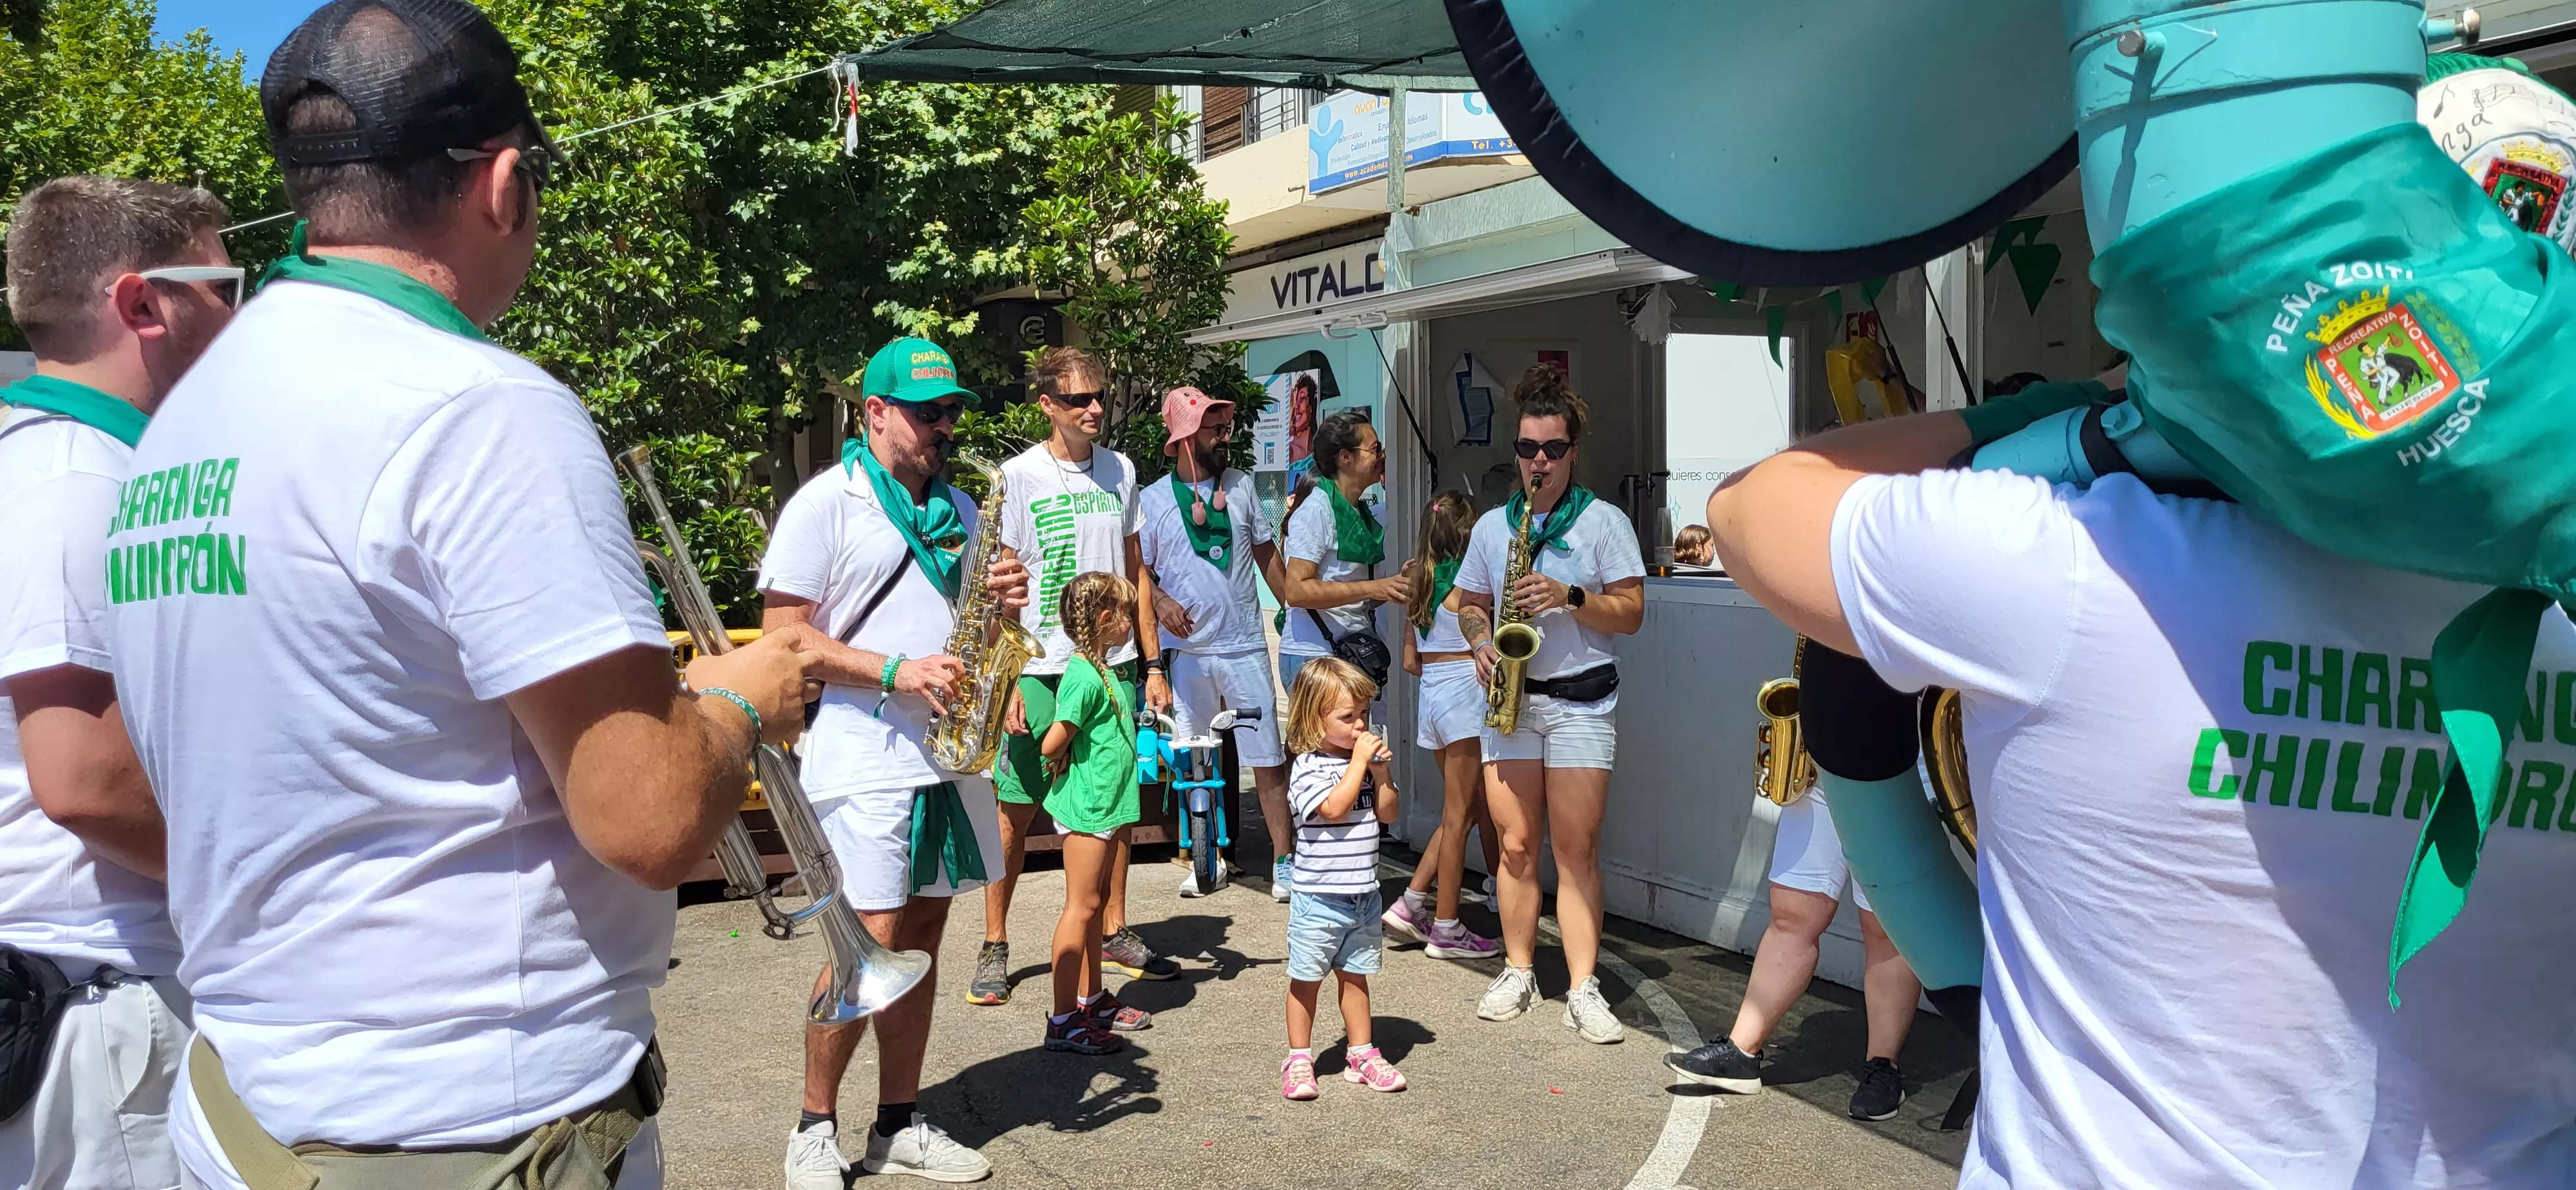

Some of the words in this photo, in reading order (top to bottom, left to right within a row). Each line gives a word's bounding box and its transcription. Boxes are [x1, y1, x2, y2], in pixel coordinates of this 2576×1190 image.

[1407, 113, 1428, 126] Idiomas
[1406, 130, 1437, 145] Desempleados
[1472, 140, 1493, 150] Tel.
[1499, 138, 1518, 148] +3
[1350, 140, 1367, 152] Calidad
[1331, 153, 1351, 165] Prevención
[1347, 155, 1367, 166] Formación
[2266, 280, 2330, 353] PEÑA
[2328, 311, 2397, 355] RECREATIVA
[2325, 358, 2376, 421] PEÑA
[2387, 386, 2438, 417] HUESCA
[2396, 377, 2490, 466] HUESCA
